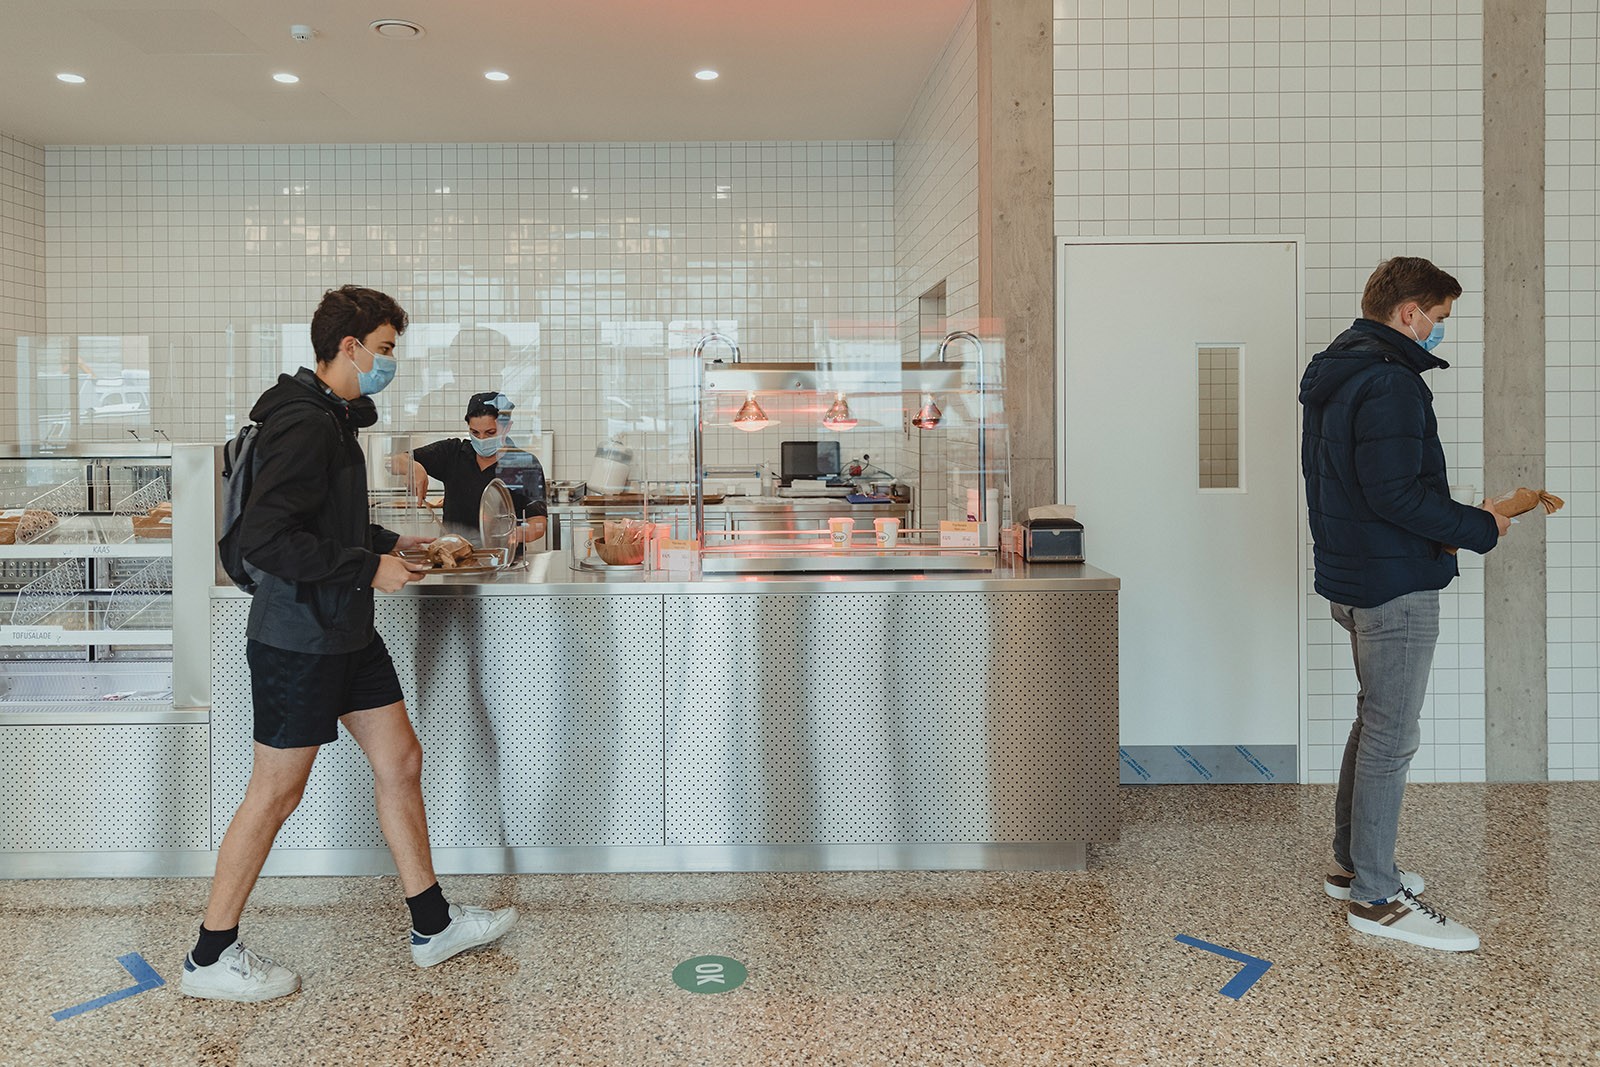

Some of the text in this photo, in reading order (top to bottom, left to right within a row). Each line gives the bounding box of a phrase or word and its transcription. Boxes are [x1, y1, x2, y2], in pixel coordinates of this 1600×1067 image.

[92, 545, 111, 554] KAAS
[12, 631, 52, 640] TOFUSALADE
[695, 963, 725, 986] OK
